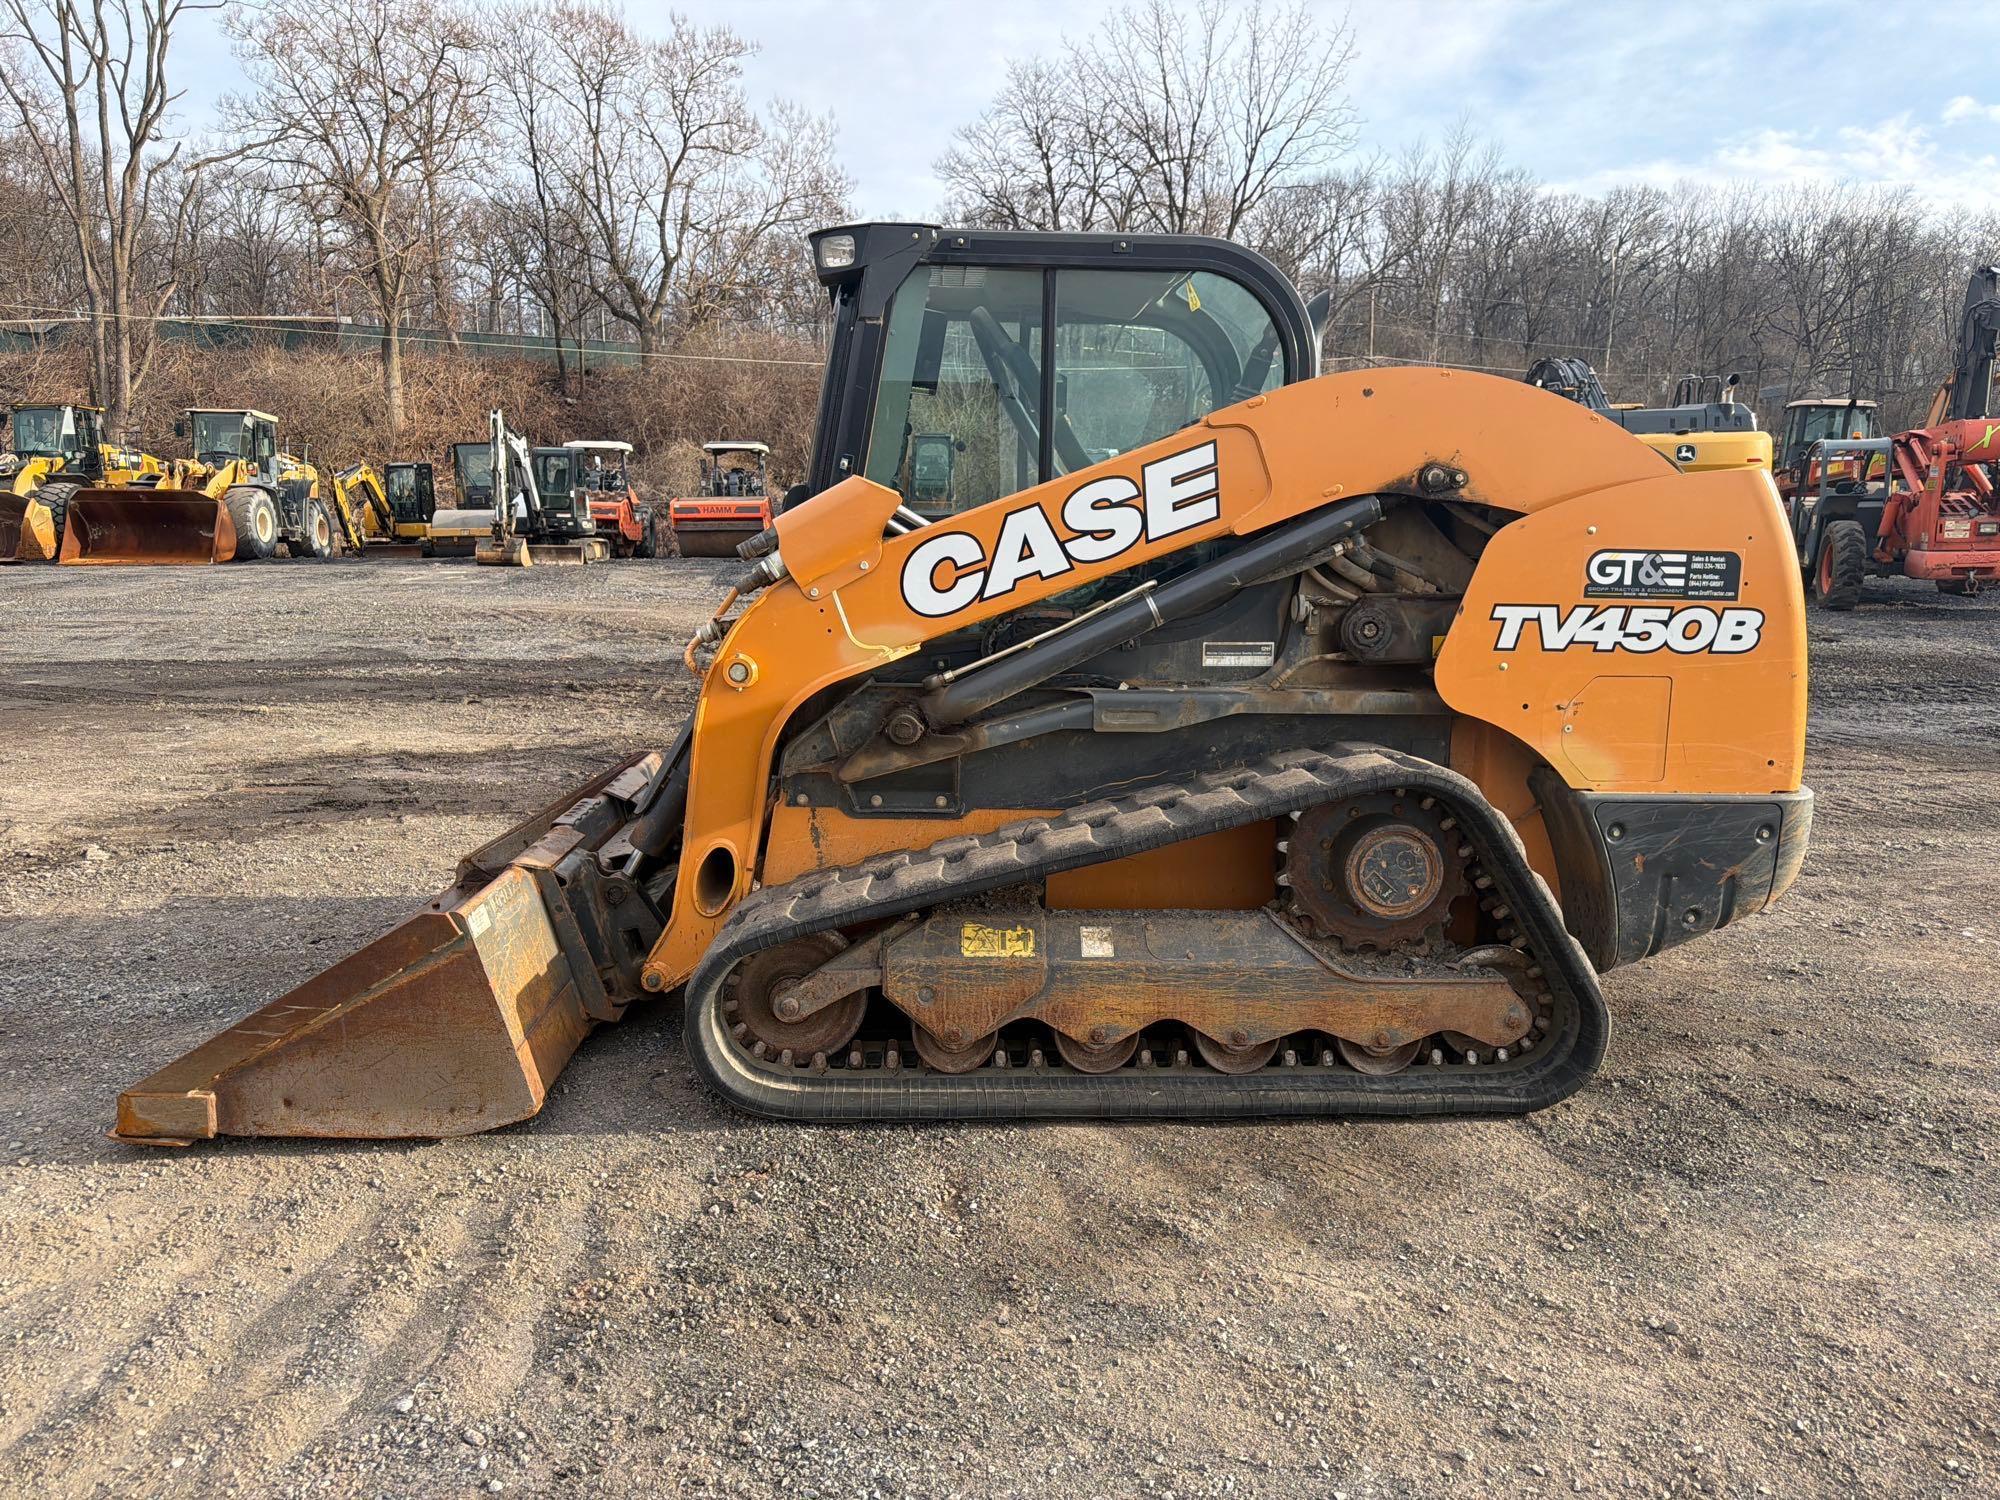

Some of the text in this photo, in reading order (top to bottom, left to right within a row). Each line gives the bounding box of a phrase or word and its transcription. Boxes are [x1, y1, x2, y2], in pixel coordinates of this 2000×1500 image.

[702, 506, 733, 514] HAMM
[900, 440, 1220, 618] CASE
[1589, 552, 1687, 586] GT&E
[1489, 604, 1764, 654] TV450B
